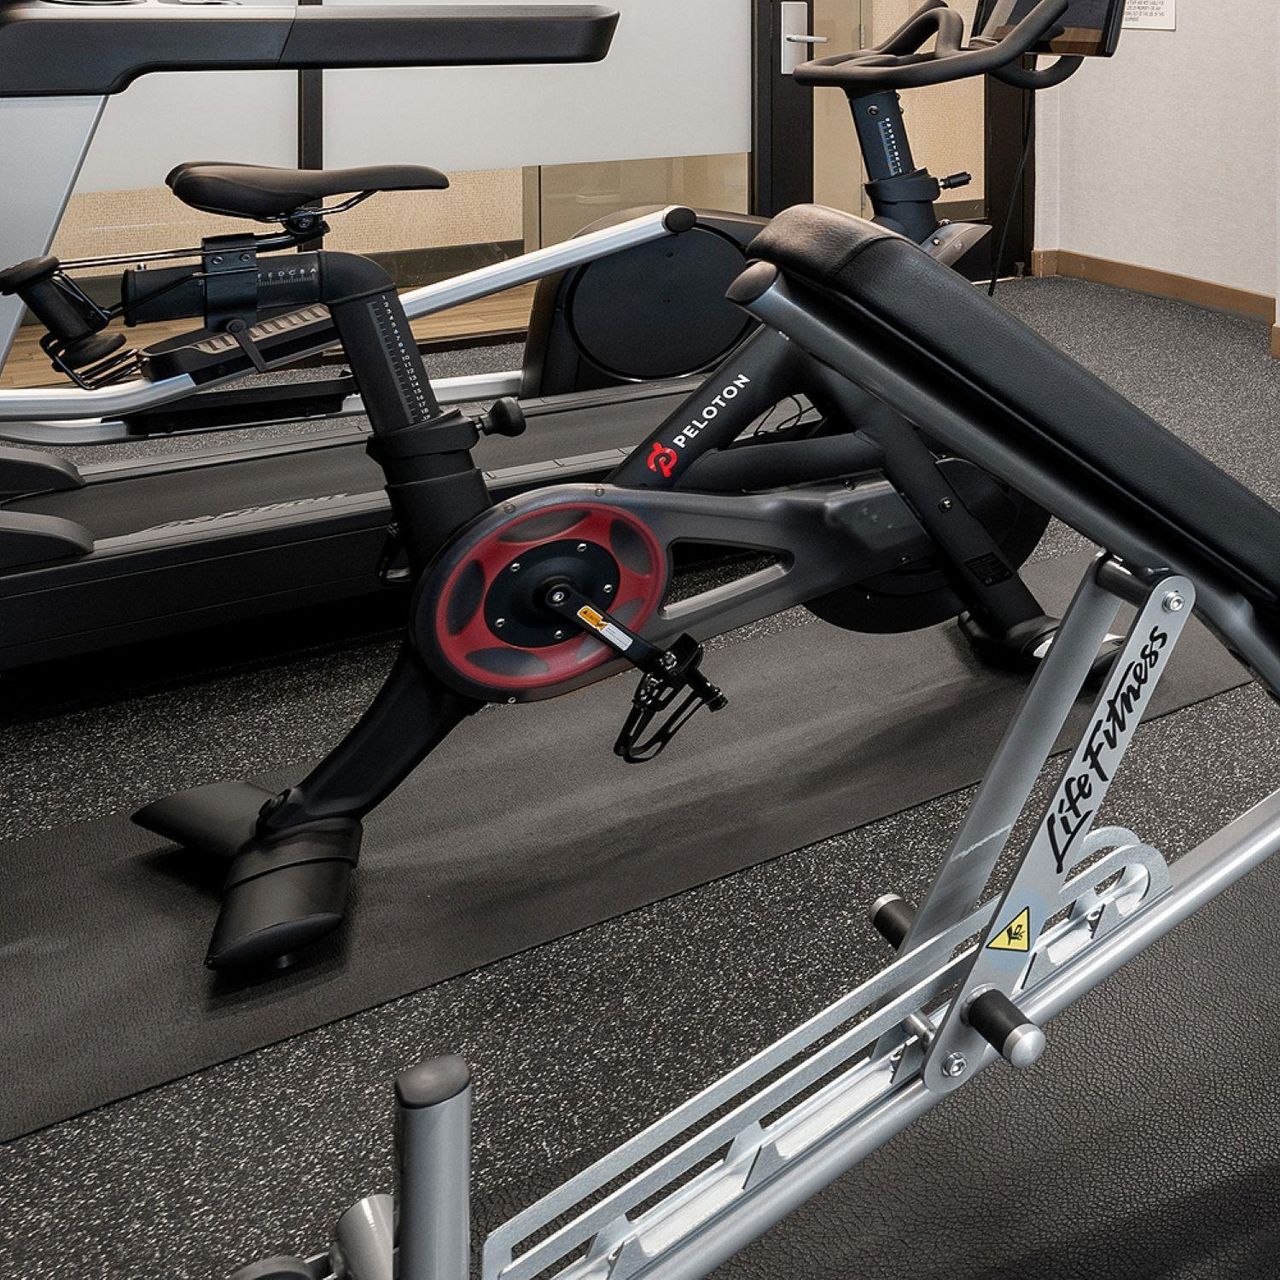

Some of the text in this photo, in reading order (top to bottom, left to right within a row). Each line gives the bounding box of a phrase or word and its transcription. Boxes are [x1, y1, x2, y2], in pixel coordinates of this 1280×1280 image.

[672, 374, 751, 448] PELOTON
[1046, 625, 1168, 874] Life Fitness
